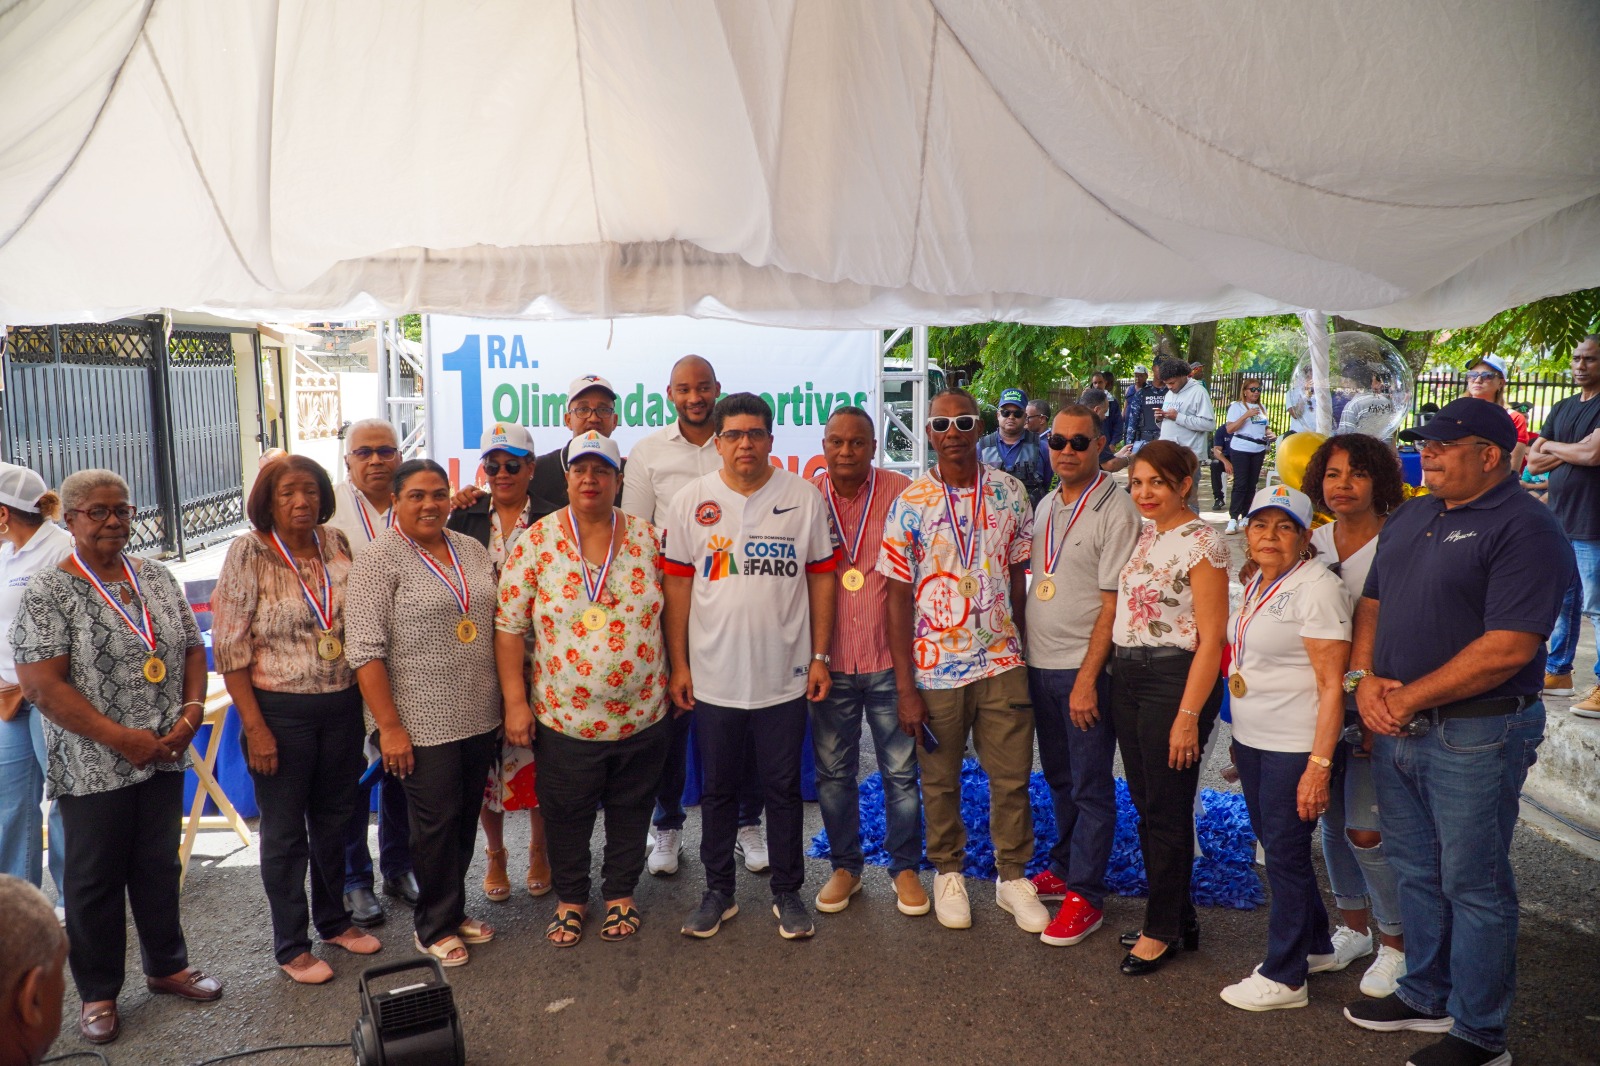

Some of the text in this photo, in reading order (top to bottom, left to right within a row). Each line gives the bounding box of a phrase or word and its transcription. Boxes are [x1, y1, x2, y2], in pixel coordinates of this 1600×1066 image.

[487, 335, 539, 368] RA.
[744, 541, 797, 559] COSTA
[750, 558, 799, 578] FARO
